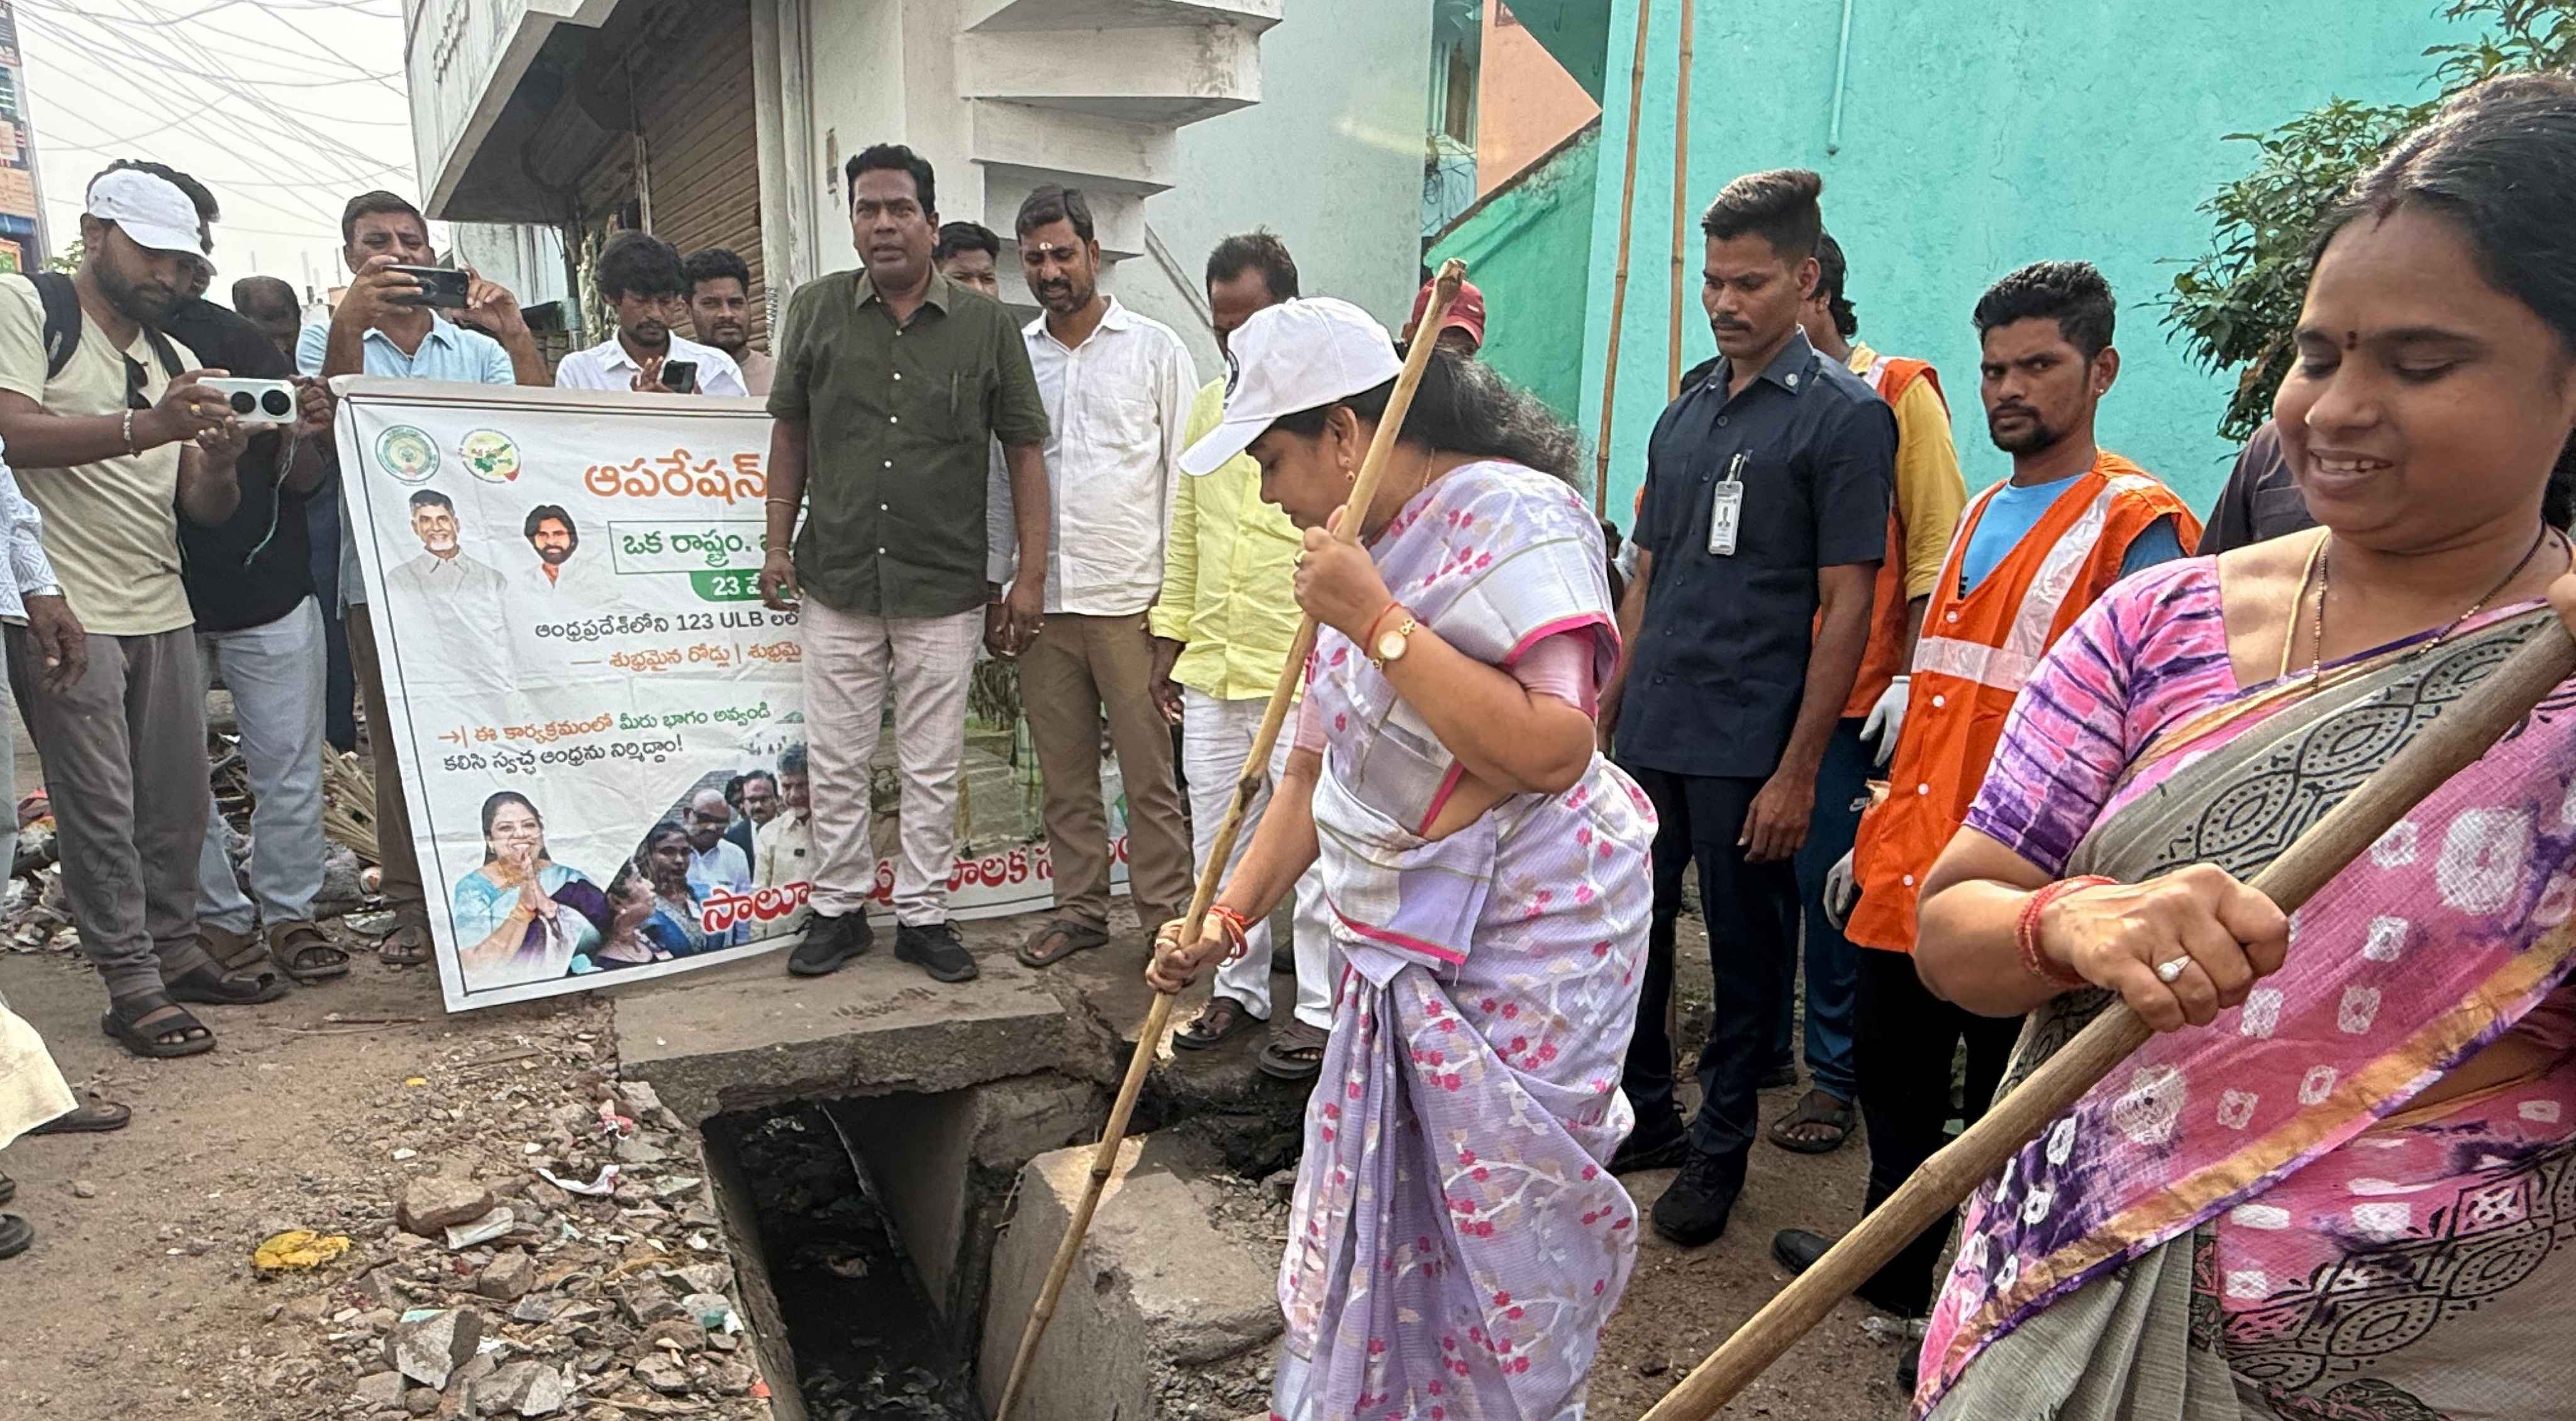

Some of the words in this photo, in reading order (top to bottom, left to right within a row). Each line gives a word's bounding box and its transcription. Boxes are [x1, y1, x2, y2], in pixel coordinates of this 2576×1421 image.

[585, 449, 767, 505] ఆపరేషన్
[623, 531, 663, 554] ఒక
[670, 529, 752, 567] రాష్ట్రం.
[712, 576, 740, 596] 23
[535, 612, 669, 642] ఆంధ్రప్రదేశ్‌లోని
[677, 614, 714, 631] 123
[720, 611, 764, 628] ULB
[609, 649, 683, 672] శుభ్రమైన
[748, 640, 802, 662] శుభ్రమై
[475, 727, 498, 742] ఈ
[503, 713, 614, 744] కార్యక్రమంలో
[619, 712, 658, 730] మీరు
[662, 710, 708, 730] భాగం
[713, 701, 771, 726] అవ్వండి
[443, 753, 487, 771] కలిసి
[540, 745, 606, 766] ఆంధ్రను
[703, 881, 812, 932] సాలూ
